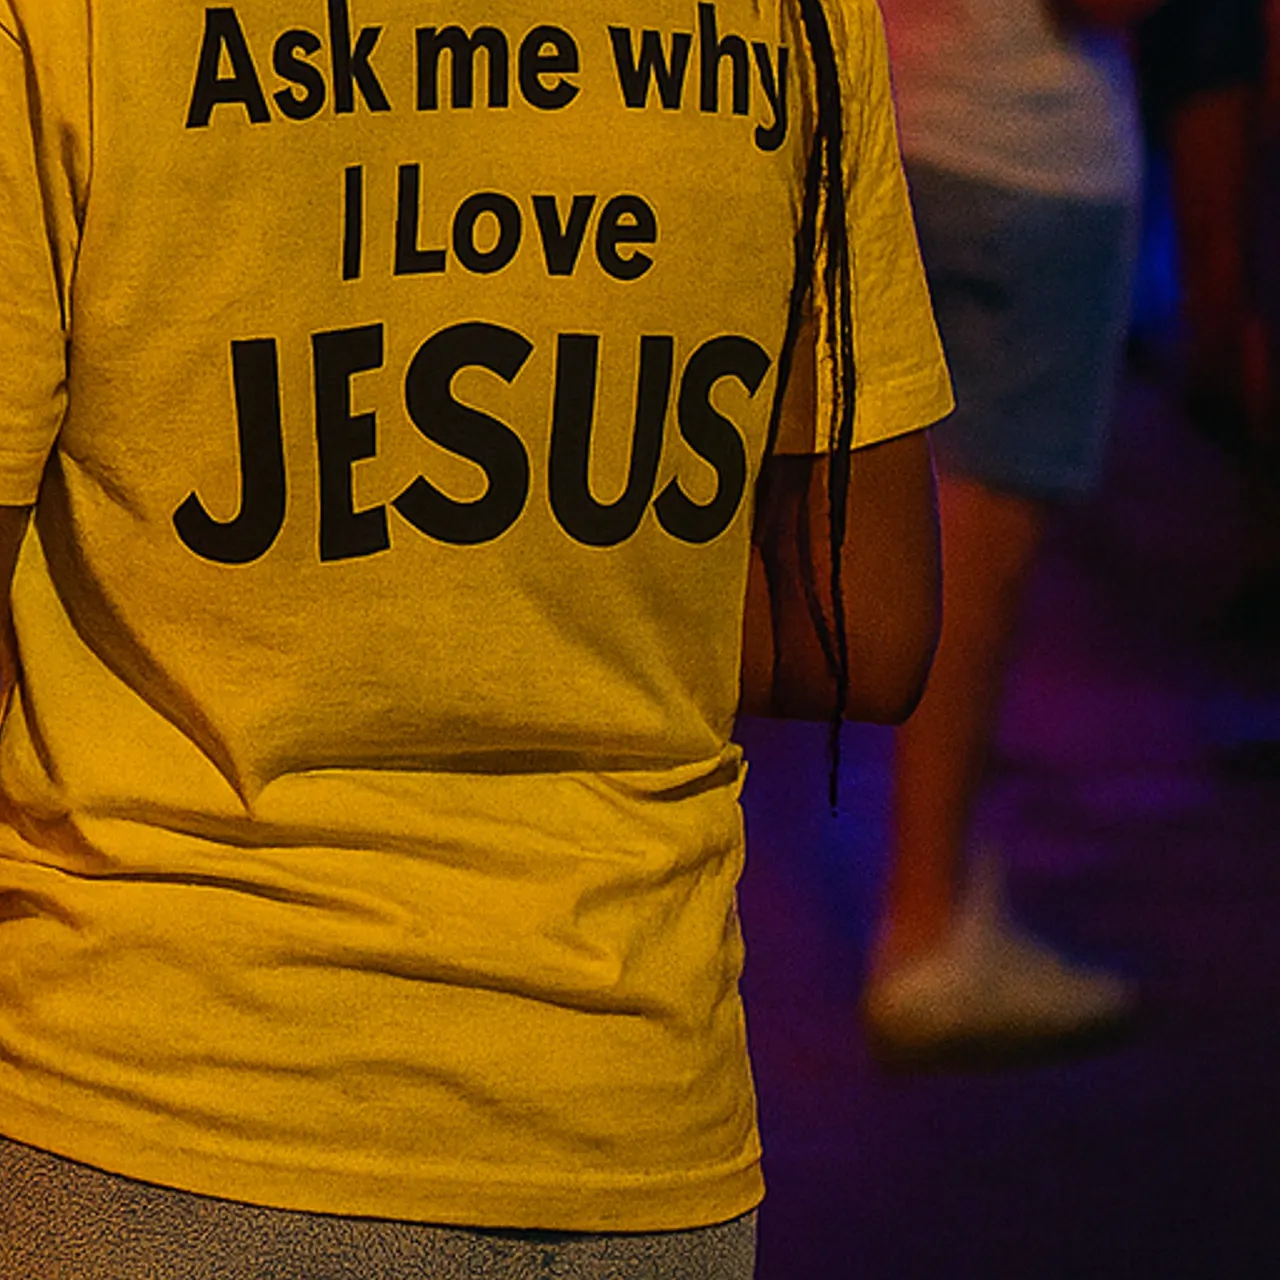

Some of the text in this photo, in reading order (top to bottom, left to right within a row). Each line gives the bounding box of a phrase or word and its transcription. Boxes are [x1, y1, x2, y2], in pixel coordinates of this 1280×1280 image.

[415, 24, 581, 112] me
[606, 1, 789, 152] why
[341, 162, 658, 282] I Love
[171, 321, 773, 566] JESUS
